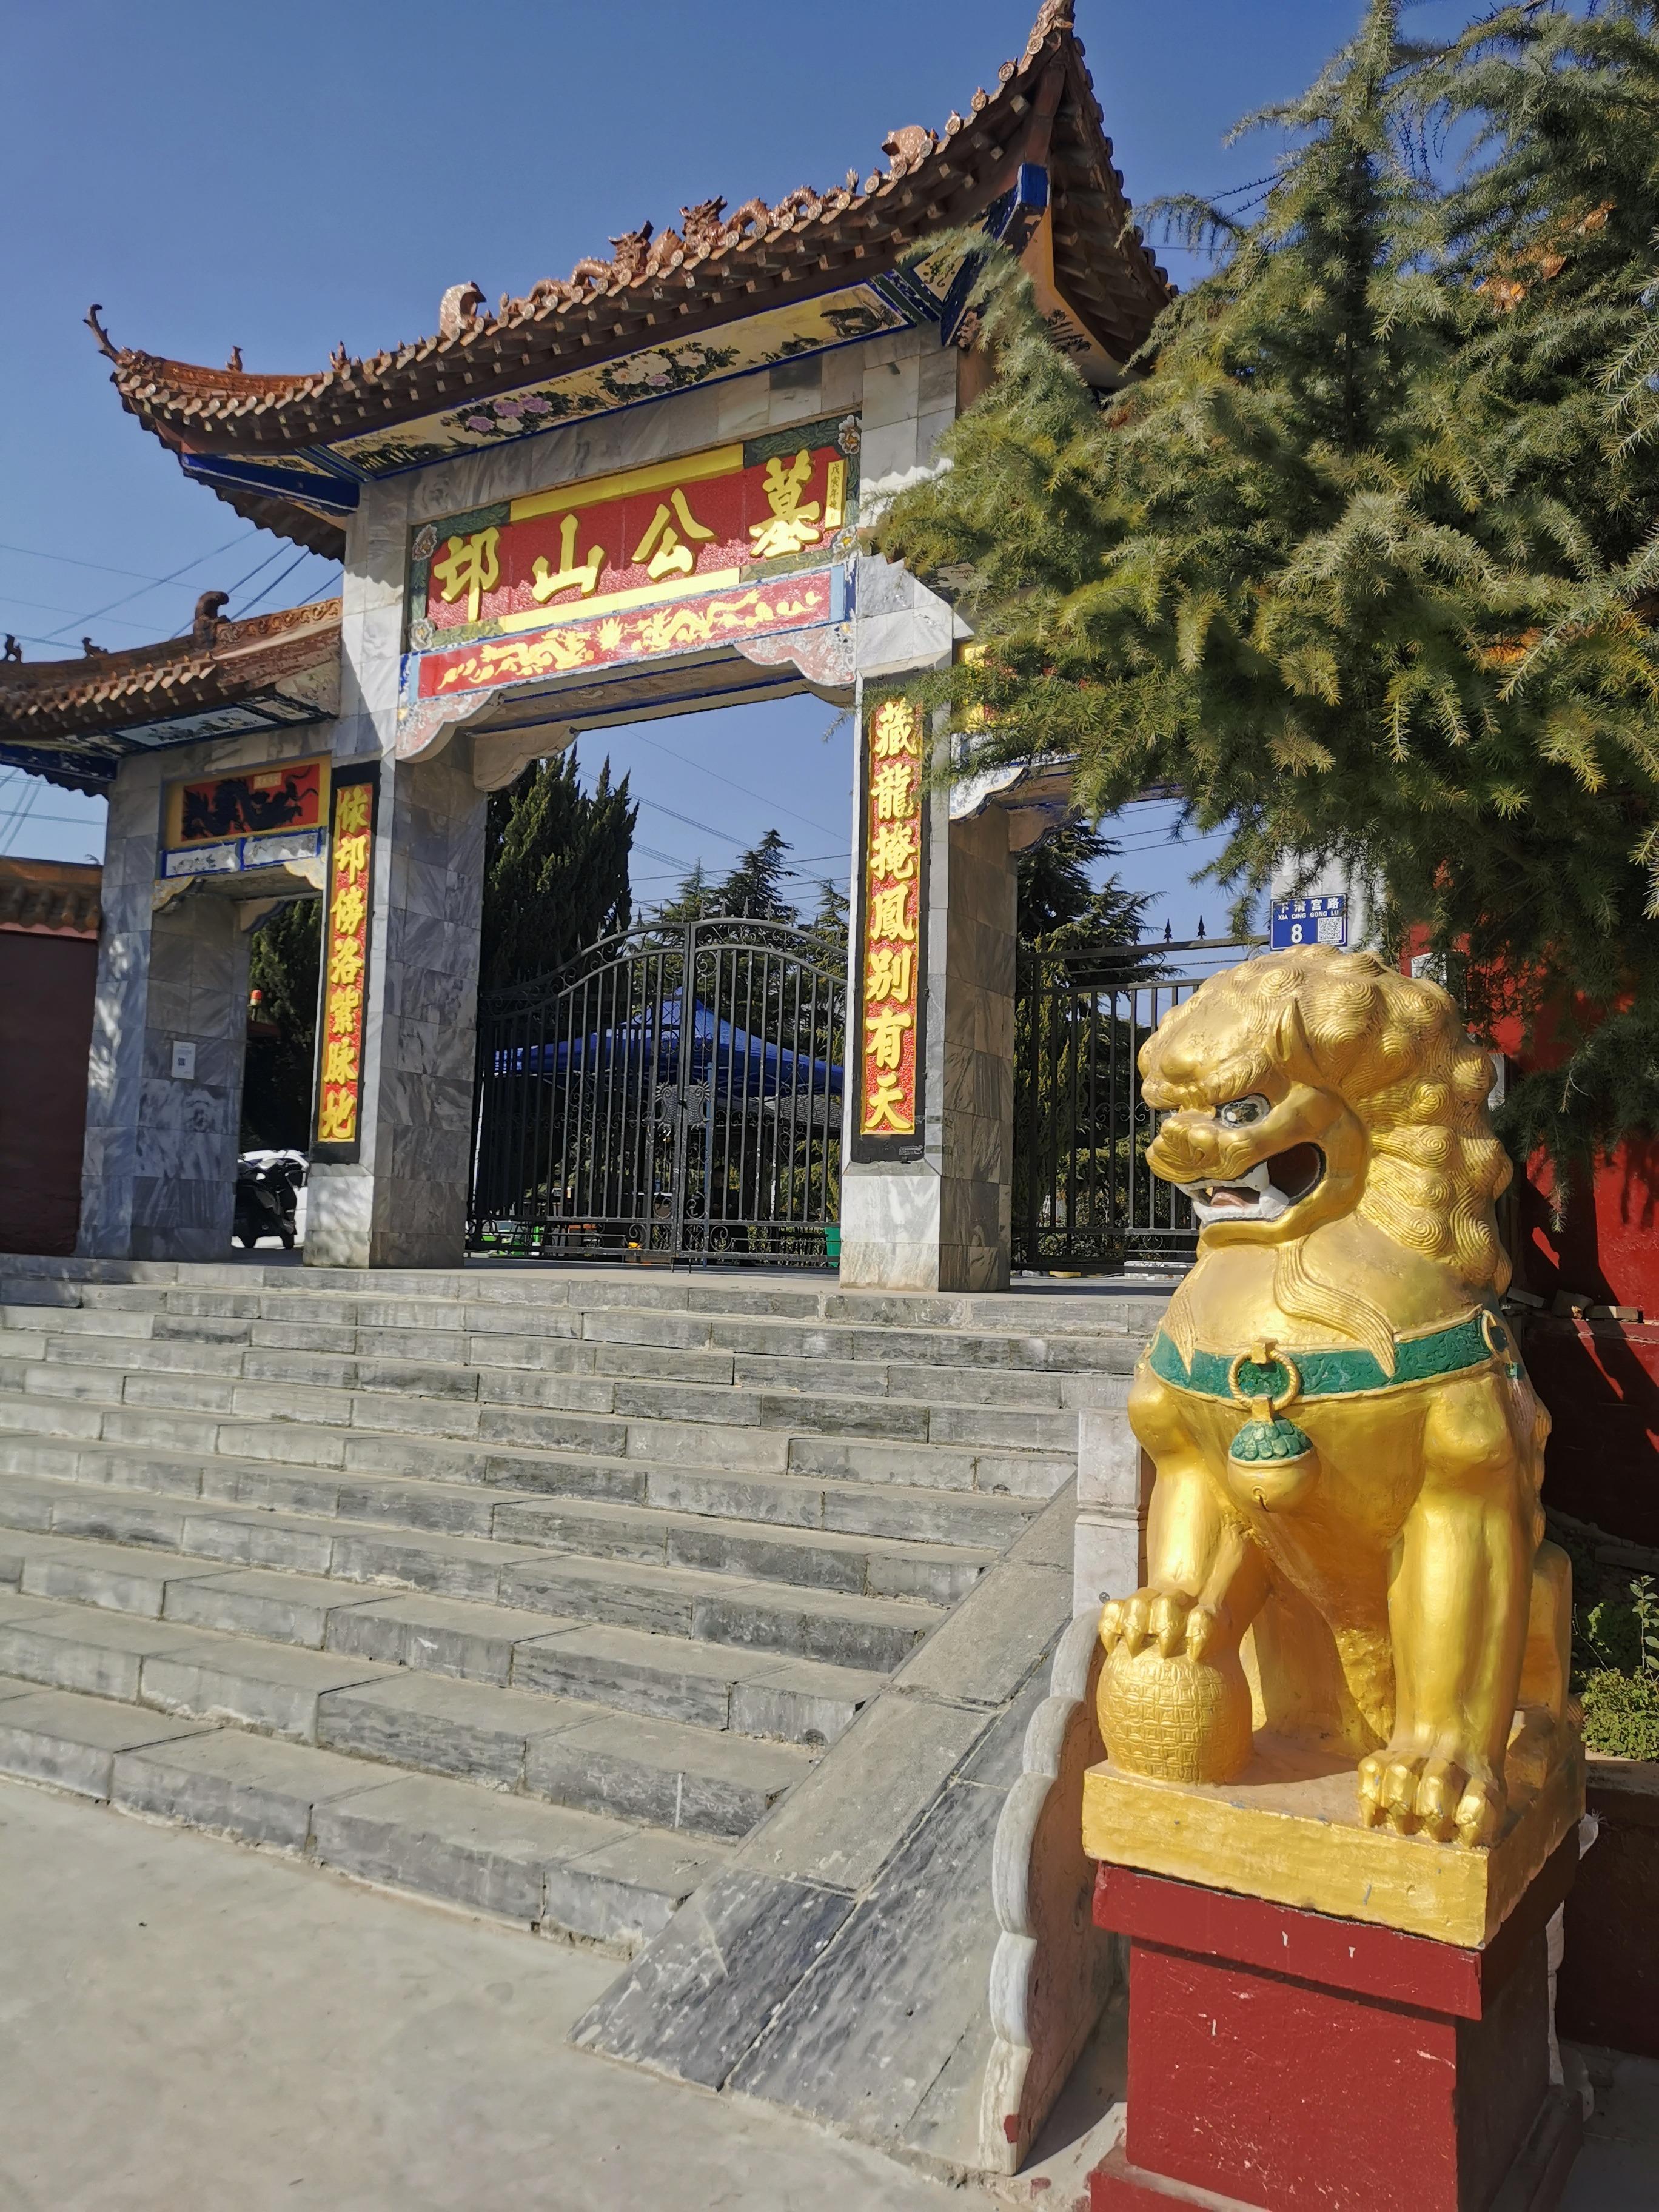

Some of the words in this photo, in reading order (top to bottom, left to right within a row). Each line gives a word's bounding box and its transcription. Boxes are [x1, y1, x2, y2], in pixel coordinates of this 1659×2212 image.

[434, 449, 823, 622] 邙山公墓
[1291, 923, 1302, 943] 8
